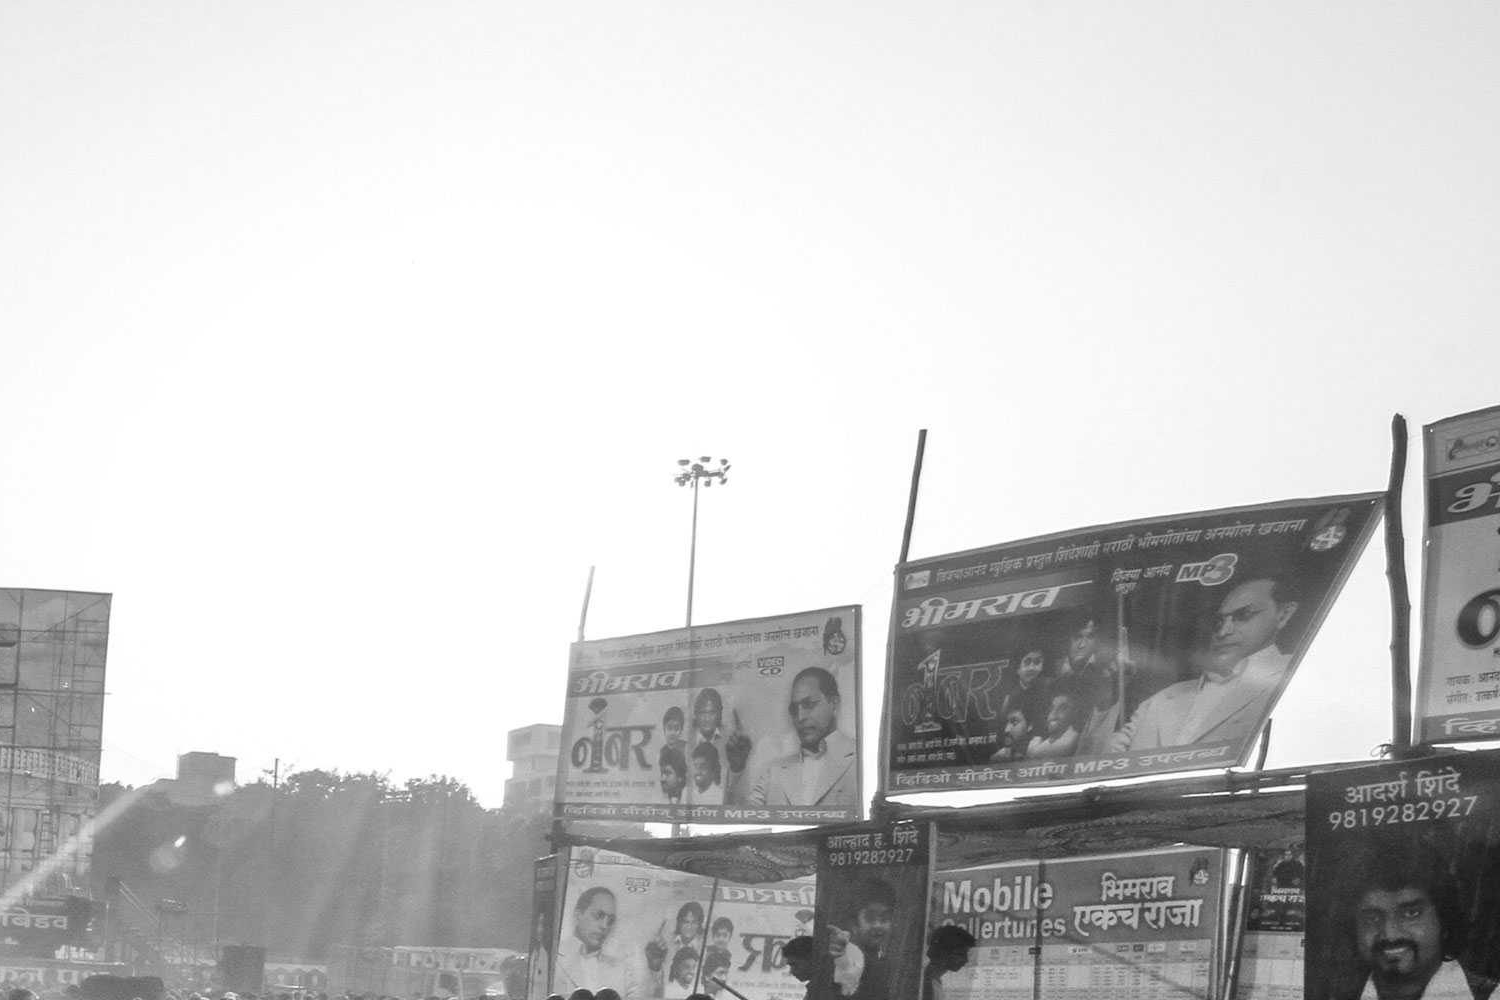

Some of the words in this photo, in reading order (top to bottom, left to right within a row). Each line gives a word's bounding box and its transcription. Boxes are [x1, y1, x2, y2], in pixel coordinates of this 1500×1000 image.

[1102, 534, 1133, 553] मराठी
[1204, 521, 1256, 541] अनमोल
[1257, 518, 1308, 537] खजाना
[1111, 567, 1142, 584] विजया
[1143, 563, 1173, 579] आनंद
[1177, 553, 1238, 586] MP3
[902, 583, 1064, 629] भीमराव
[758, 657, 784, 668] VIDEO
[759, 667, 782, 676] CD
[573, 669, 689, 695] भीमराव
[896, 769, 951, 786] व्हिडिओ
[1016, 762, 1067, 778] आणि
[1074, 758, 1131, 774] MP3
[1138, 746, 1231, 766] उपलब्ध
[1345, 771, 1409, 803] आदर्श
[1414, 766, 1462, 797] शिंदे
[724, 809, 771, 819] MP3
[1329, 795, 1478, 831] 9819282927
[827, 834, 870, 849] आल्हाद
[892, 825, 919, 845] शिंदे
[829, 848, 914, 866] 9819282927
[943, 875, 1053, 914] Mobile
[1101, 871, 1175, 902] भिमराव
[1073, 902, 1142, 937] एकच
[1143, 899, 1203, 929] राजा
